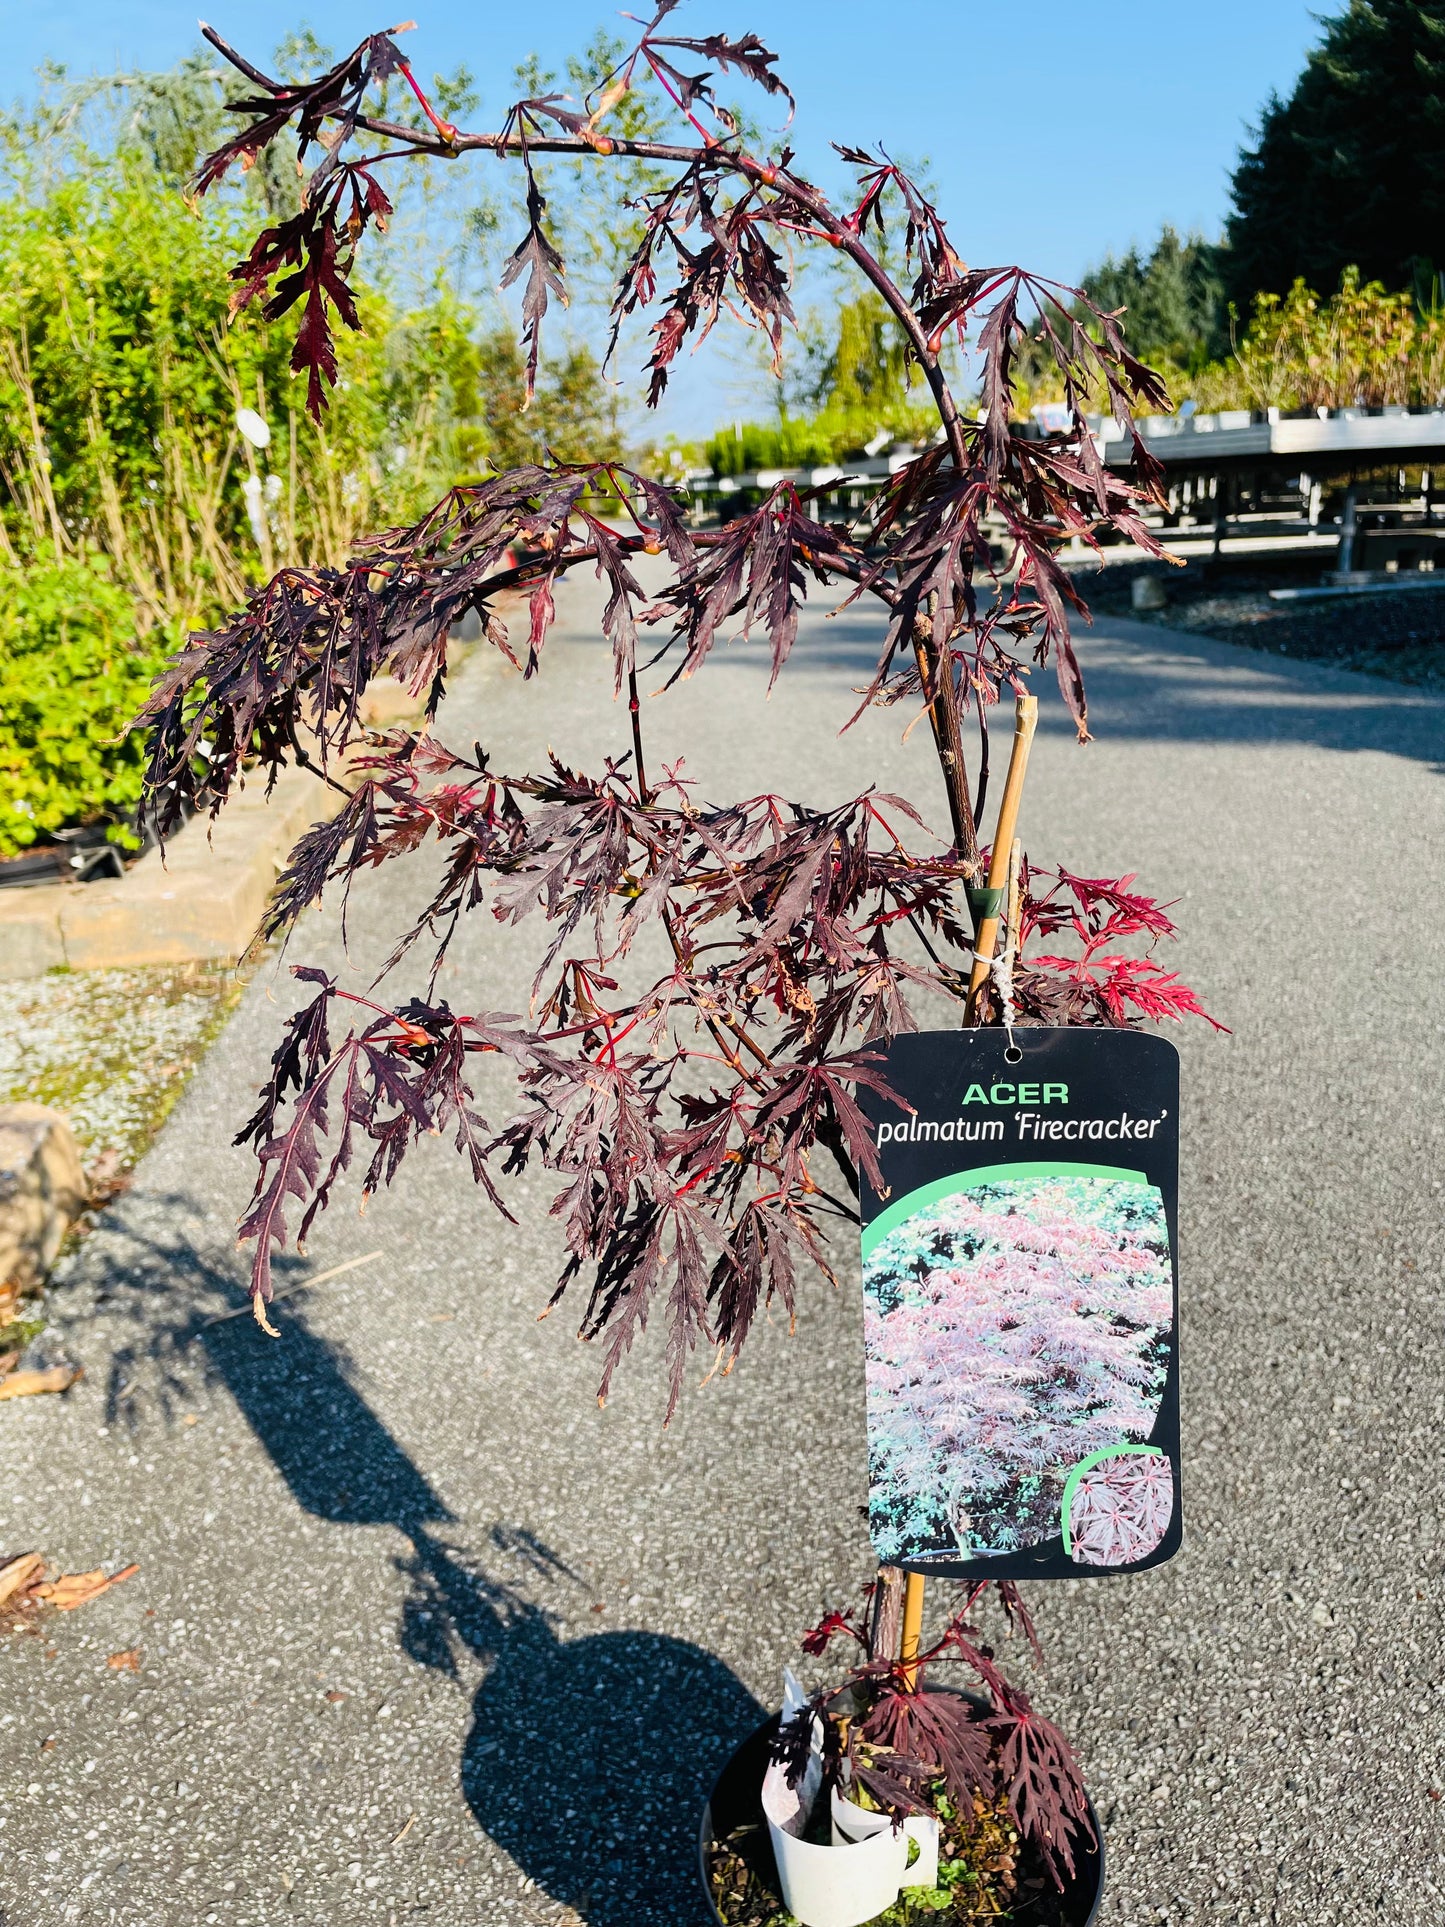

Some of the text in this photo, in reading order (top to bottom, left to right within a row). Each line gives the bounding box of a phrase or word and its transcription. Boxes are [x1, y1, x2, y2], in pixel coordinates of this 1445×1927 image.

[961, 1083, 1069, 1105] ACER
[877, 1110, 1168, 1149] palmatum 'Firecracker'
